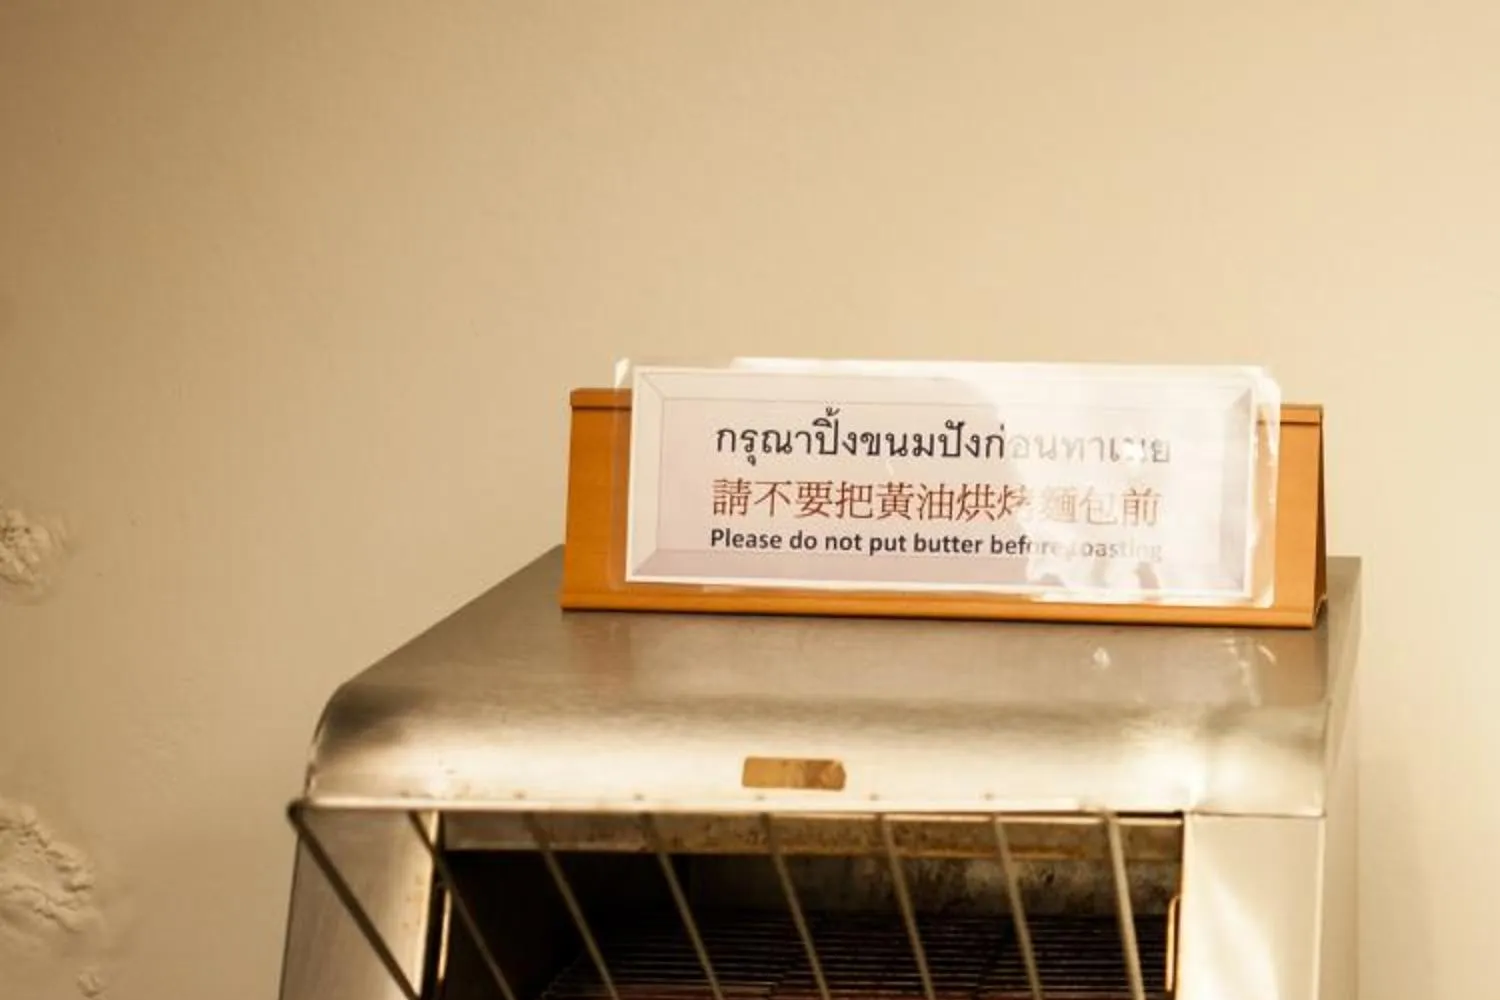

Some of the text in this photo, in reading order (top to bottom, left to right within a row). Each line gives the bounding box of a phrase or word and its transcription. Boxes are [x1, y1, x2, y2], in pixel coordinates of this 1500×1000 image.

[710, 528, 783, 549] Please
[789, 530, 818, 550] do
[825, 533, 863, 551] not
[869, 534, 907, 556] put
[913, 533, 984, 554] butter
[990, 535, 1060, 556] before
